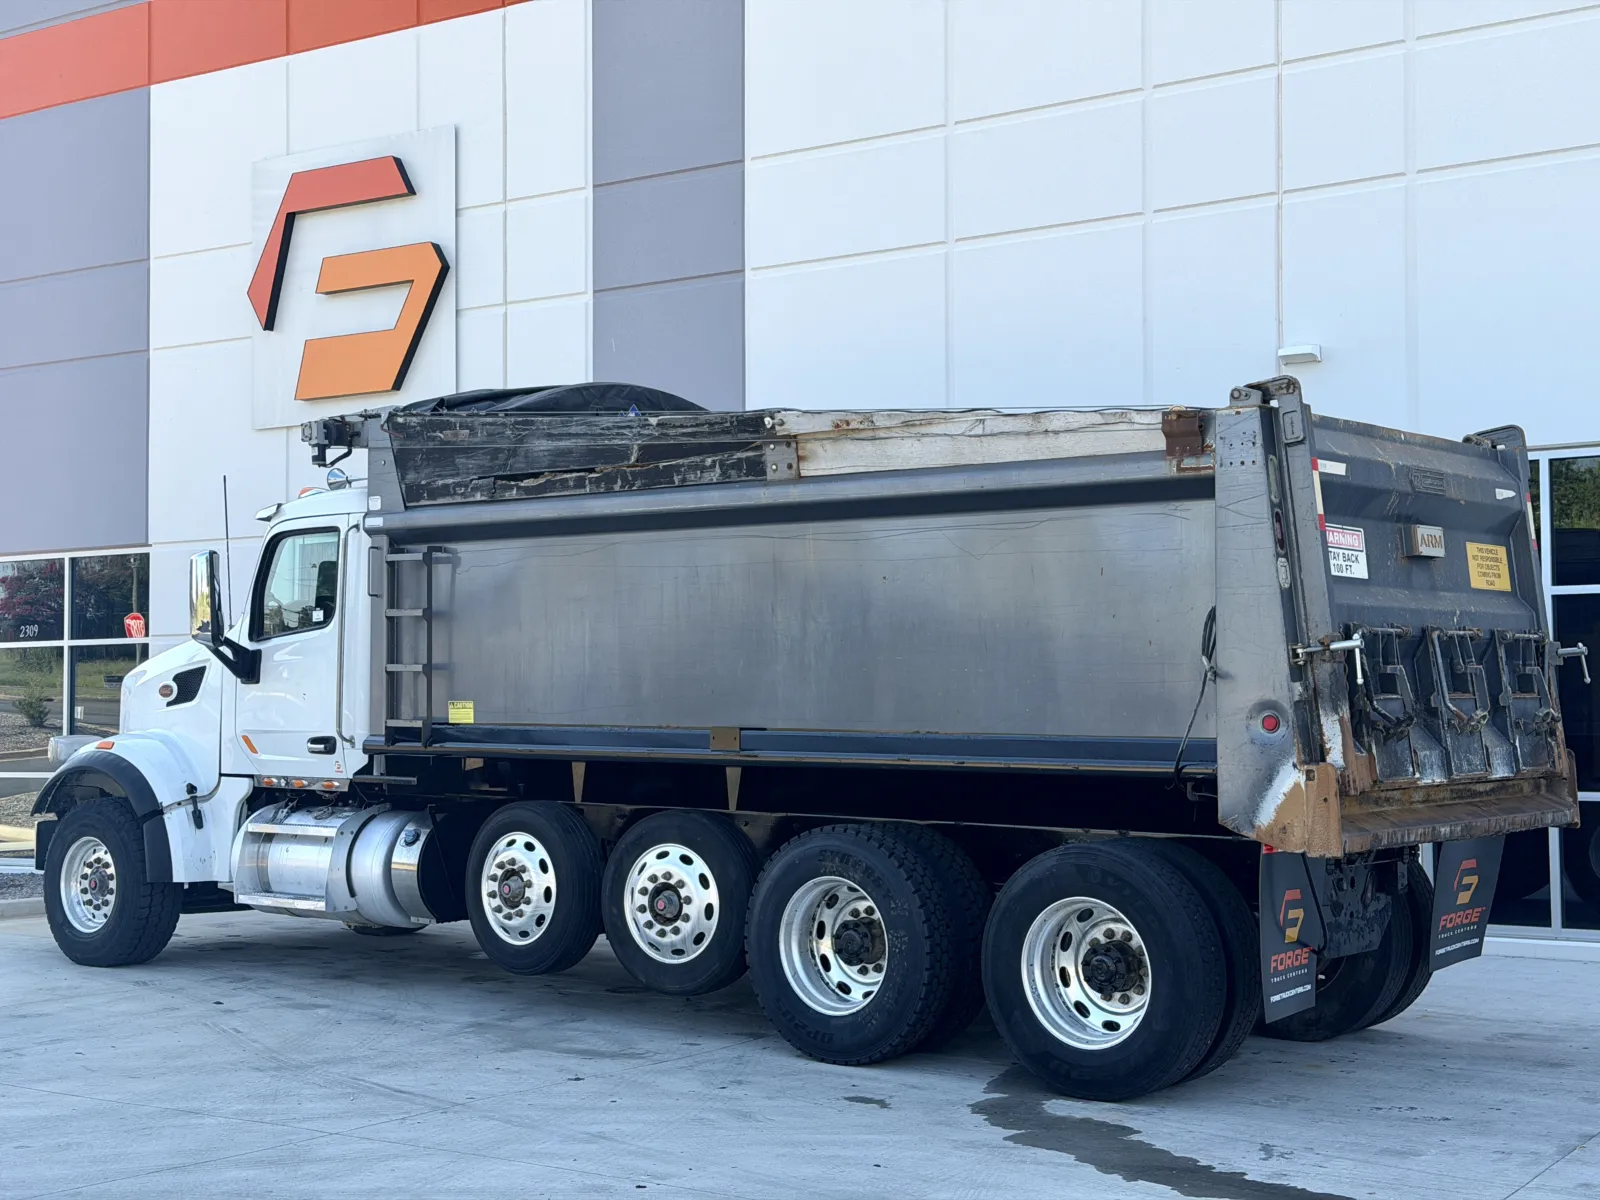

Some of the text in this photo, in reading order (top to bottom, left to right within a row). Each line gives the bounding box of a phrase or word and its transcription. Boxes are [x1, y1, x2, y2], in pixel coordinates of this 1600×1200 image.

[1326, 530, 1359, 547] ARNING
[1420, 533, 1443, 549] ARM
[1329, 551, 1360, 564] TAY BACK
[1484, 548, 1499, 556] VEHICLE
[1472, 554, 1503, 564] NOT RESPONSIBLE
[1333, 563, 1355, 575] 100 FT.
[1477, 571, 1491, 579] COMING
[20, 624, 39, 638] 2309
[1439, 907, 1482, 931] FORGE
[1270, 948, 1310, 974] FORGE
